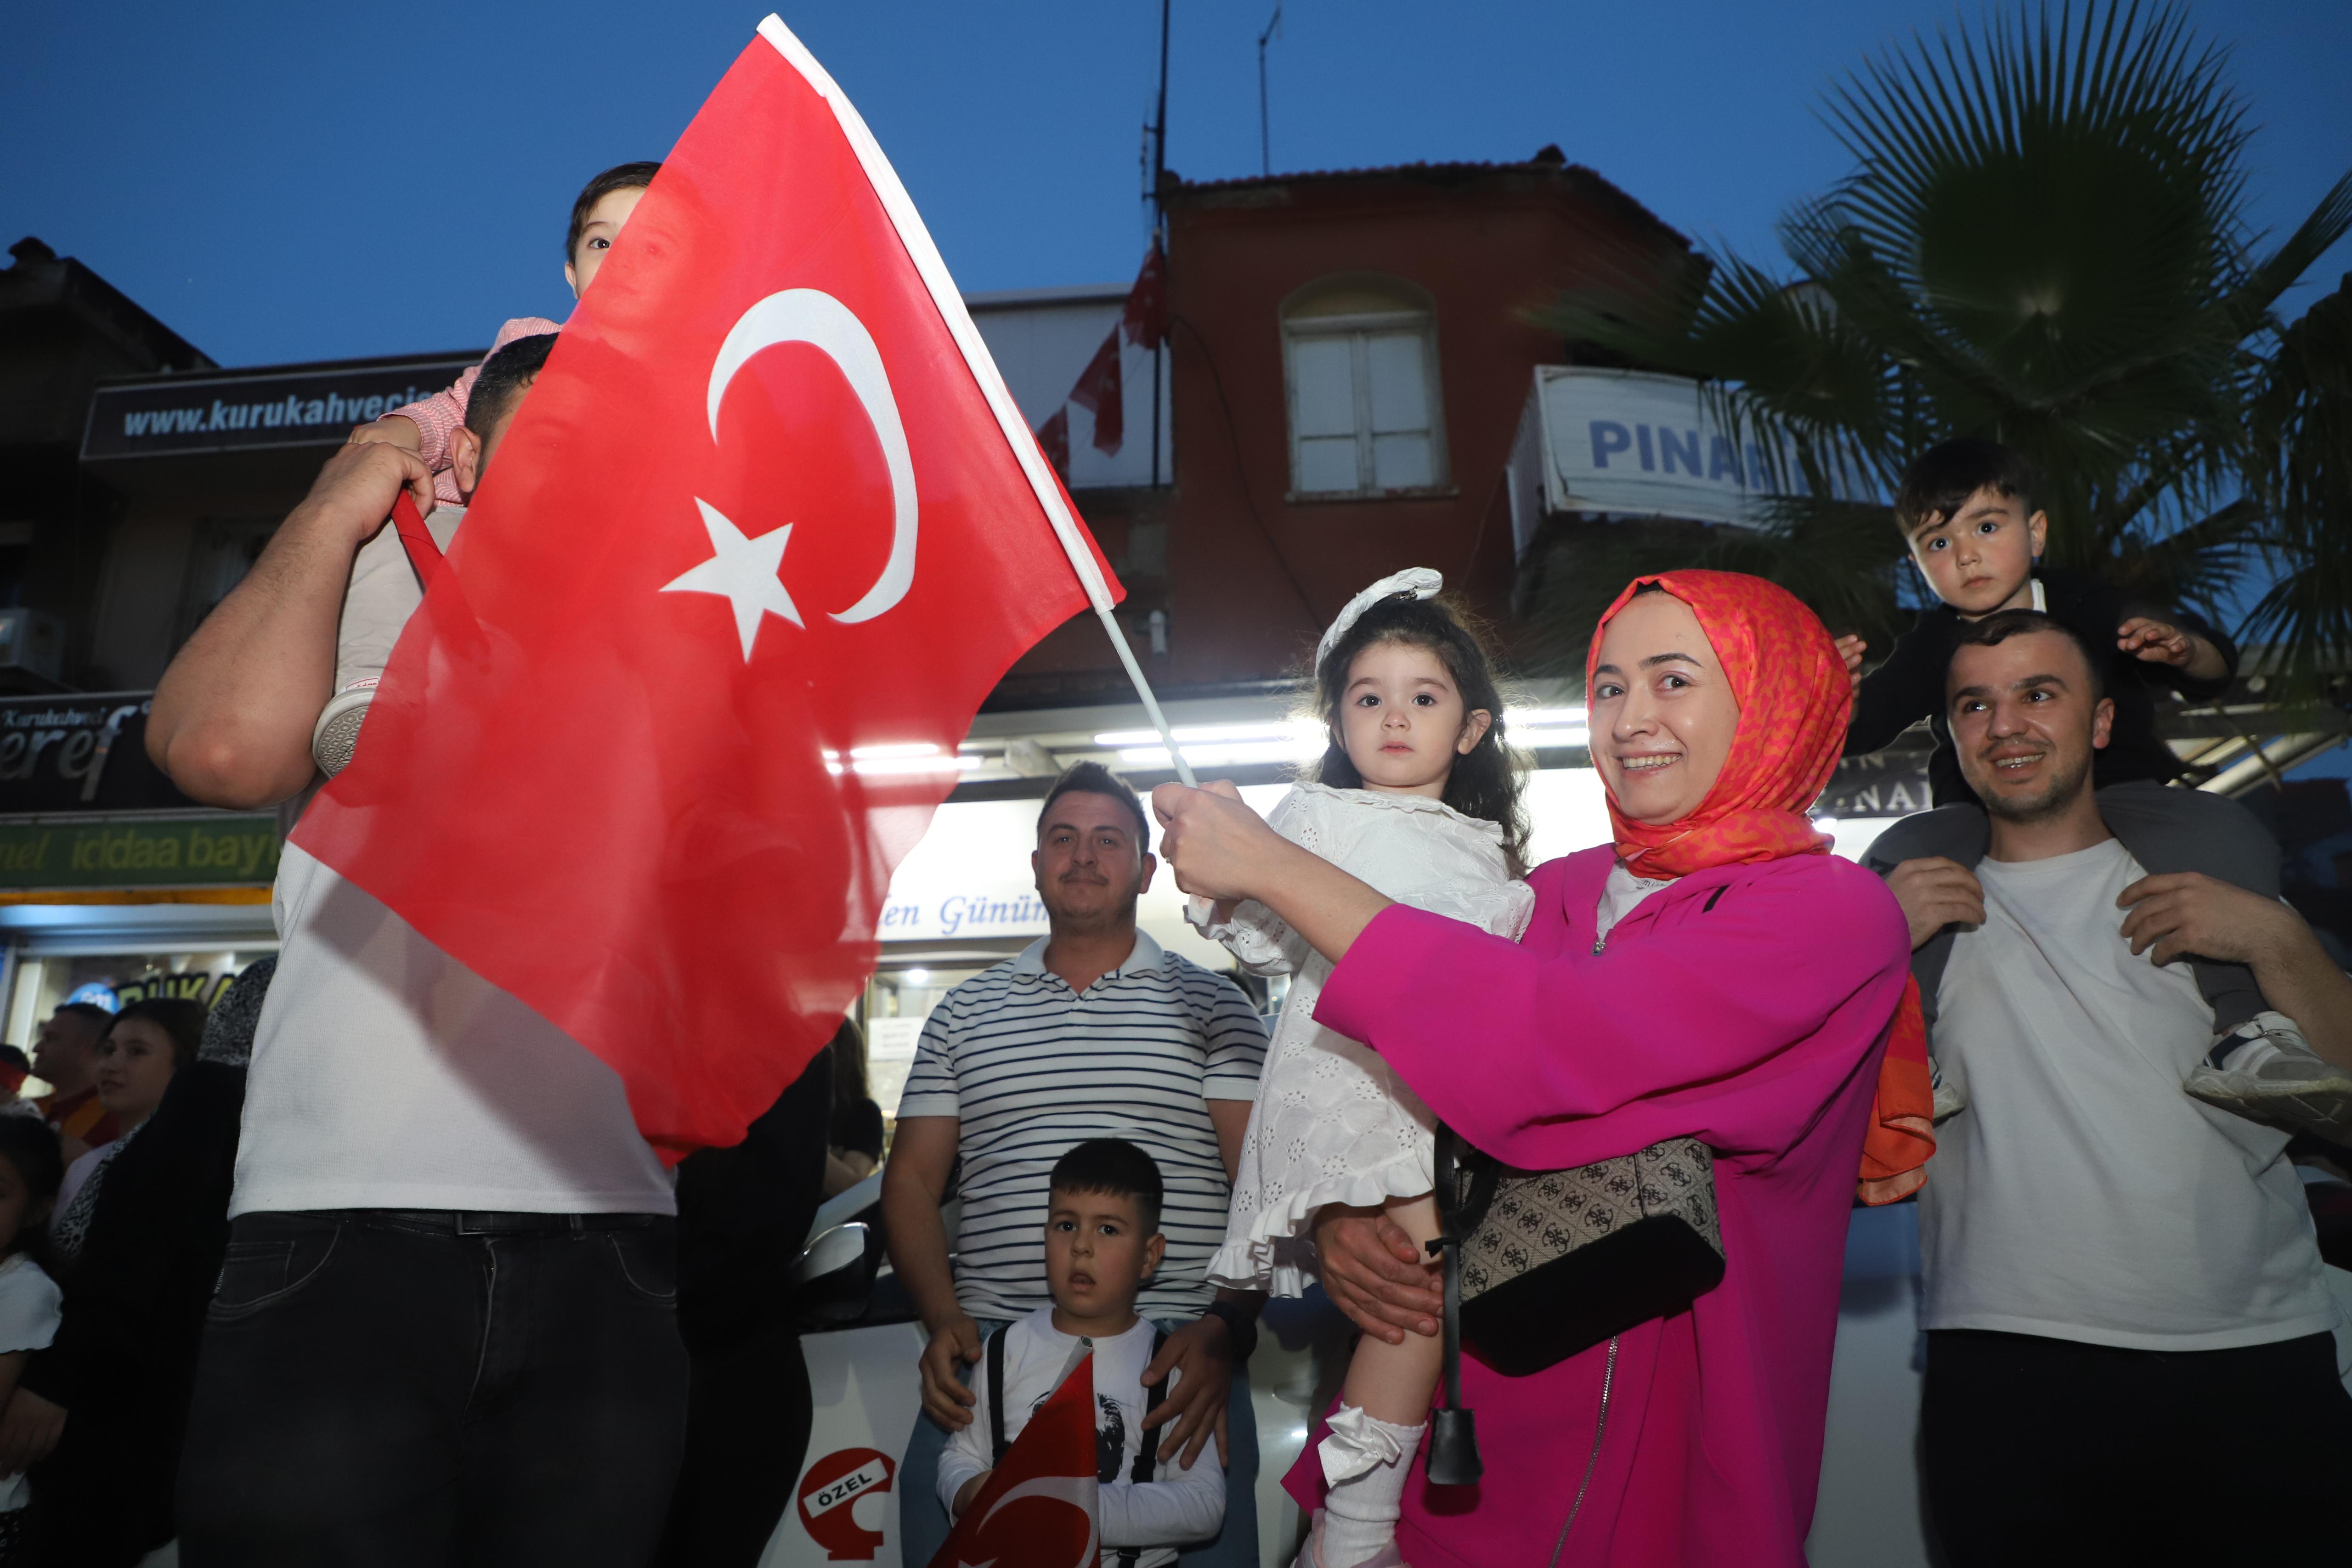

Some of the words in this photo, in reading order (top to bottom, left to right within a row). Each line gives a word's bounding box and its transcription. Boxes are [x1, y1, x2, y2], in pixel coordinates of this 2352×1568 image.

[71, 829, 181, 870] iddaa
[877, 903, 918, 927] en
[817, 1472, 872, 1507] ÖZEL
